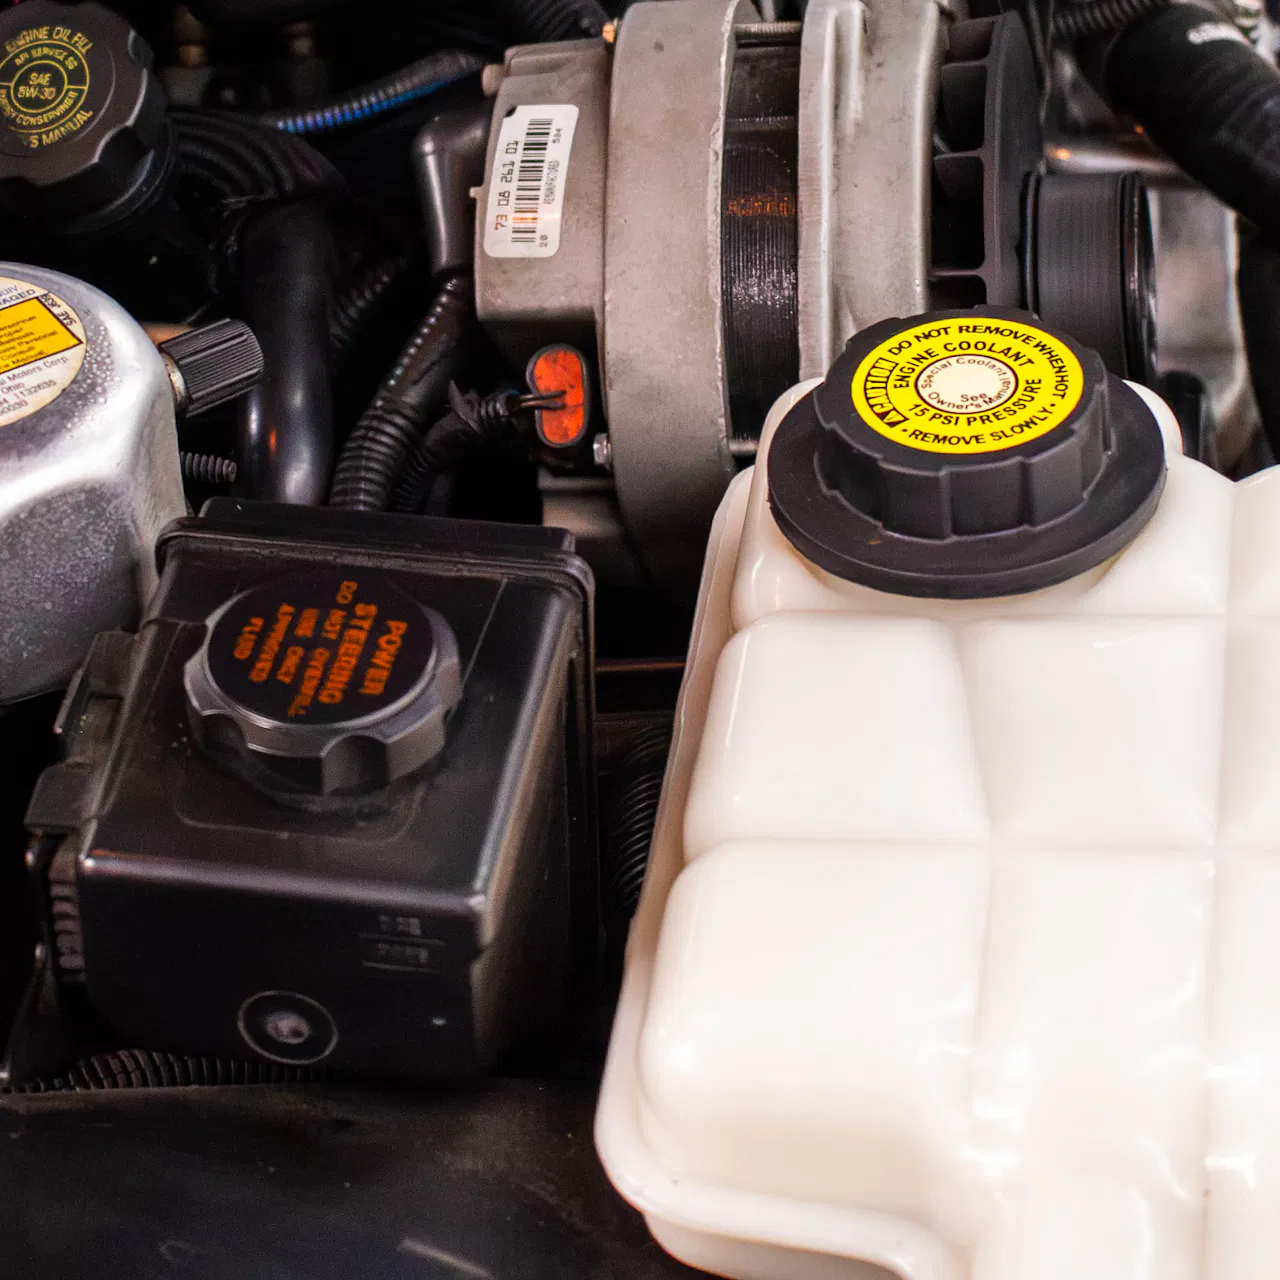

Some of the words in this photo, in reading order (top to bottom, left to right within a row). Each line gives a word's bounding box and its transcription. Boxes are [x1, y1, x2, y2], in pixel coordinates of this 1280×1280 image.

[4, 25, 50, 53] ENGINE
[52, 26, 72, 42] OIL
[71, 32, 93, 55] FILL
[29, 71, 52, 86] SAE
[17, 86, 56, 100] 5W-30
[42, 110, 94, 146] MANUAL
[505, 139, 519, 154] 01
[500, 161, 515, 184] 261
[497, 190, 510, 207] 08
[494, 214, 508, 231] 73
[56, 310, 76, 325] SAE
[865, 356, 899, 414] CAUTION
[887, 339, 912, 356] DO
[916, 326, 953, 343] NOT
[957, 325, 1036, 346] REMOVE
[893, 348, 939, 389] ENGINE
[943, 341, 1036, 368] COOLANT
[921, 360, 952, 389] Special
[956, 357, 1006, 376] Coolant
[907, 403, 927, 419] 15
[928, 412, 960, 427] PSI
[966, 377, 1043, 427] PRESSURE
[928, 391, 982, 410] Owner's
[960, 393, 988, 403] See
[908, 428, 987, 446] REMOVE
[991, 403, 1053, 442] SLOWLY
[317, 602, 379, 705] STEERING
[358, 619, 409, 697] POWER
